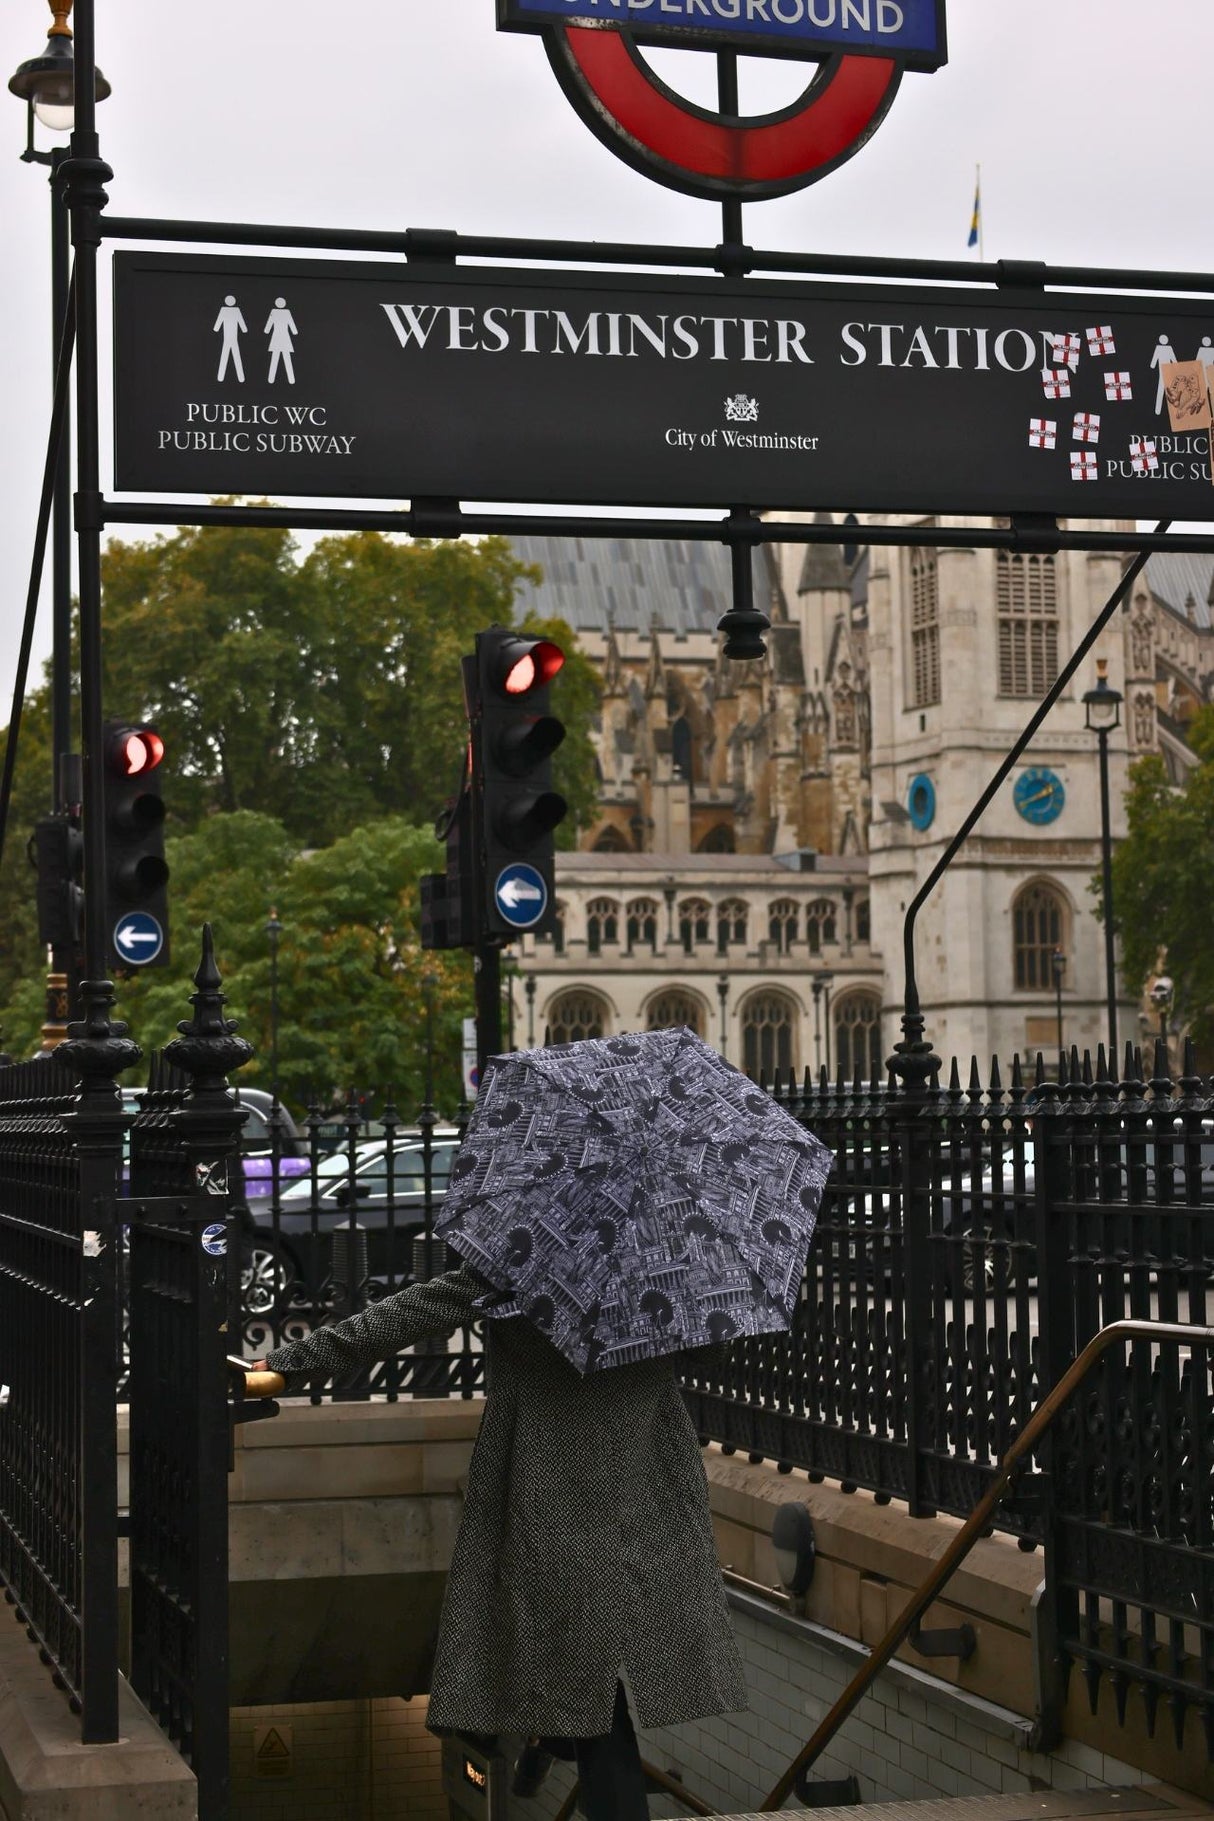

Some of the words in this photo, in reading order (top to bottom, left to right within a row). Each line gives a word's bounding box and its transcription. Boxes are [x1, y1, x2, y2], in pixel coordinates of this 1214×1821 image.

[564, 0, 904, 34] GROUND
[380, 303, 815, 363] WESTMINSTER
[187, 404, 278, 424] PUBLIC
[284, 407, 327, 426] WC
[158, 430, 251, 452] PUBLIC
[256, 433, 357, 455] SUBWAY
[665, 428, 697, 451] City
[700, 429, 718, 447] of
[721, 430, 819, 450] Westminster
